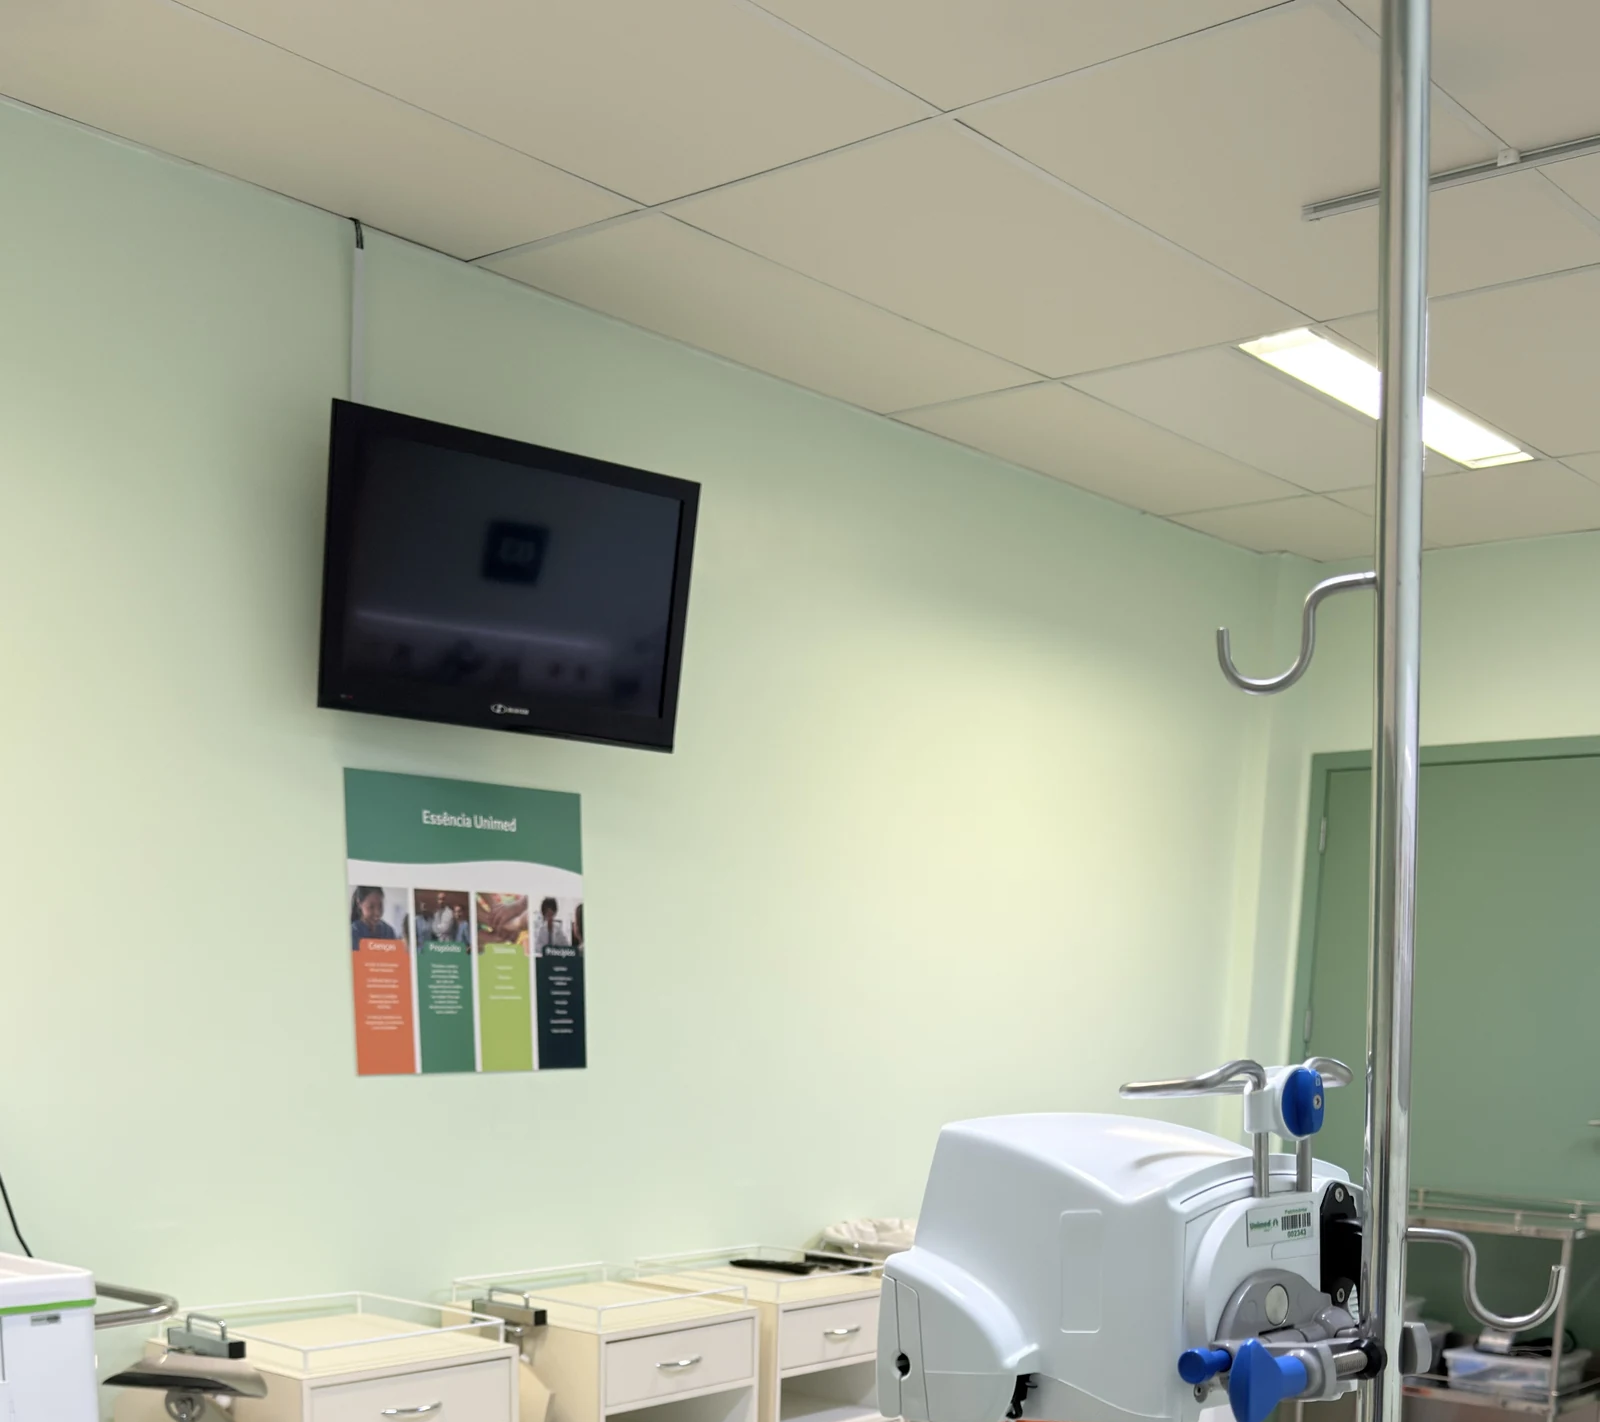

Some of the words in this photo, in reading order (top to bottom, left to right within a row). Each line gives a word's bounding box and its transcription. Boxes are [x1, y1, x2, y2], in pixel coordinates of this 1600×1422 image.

[422, 809, 472, 828] Essência
[473, 814, 517, 832] Unimed
[429, 943, 462, 954] Propósito
